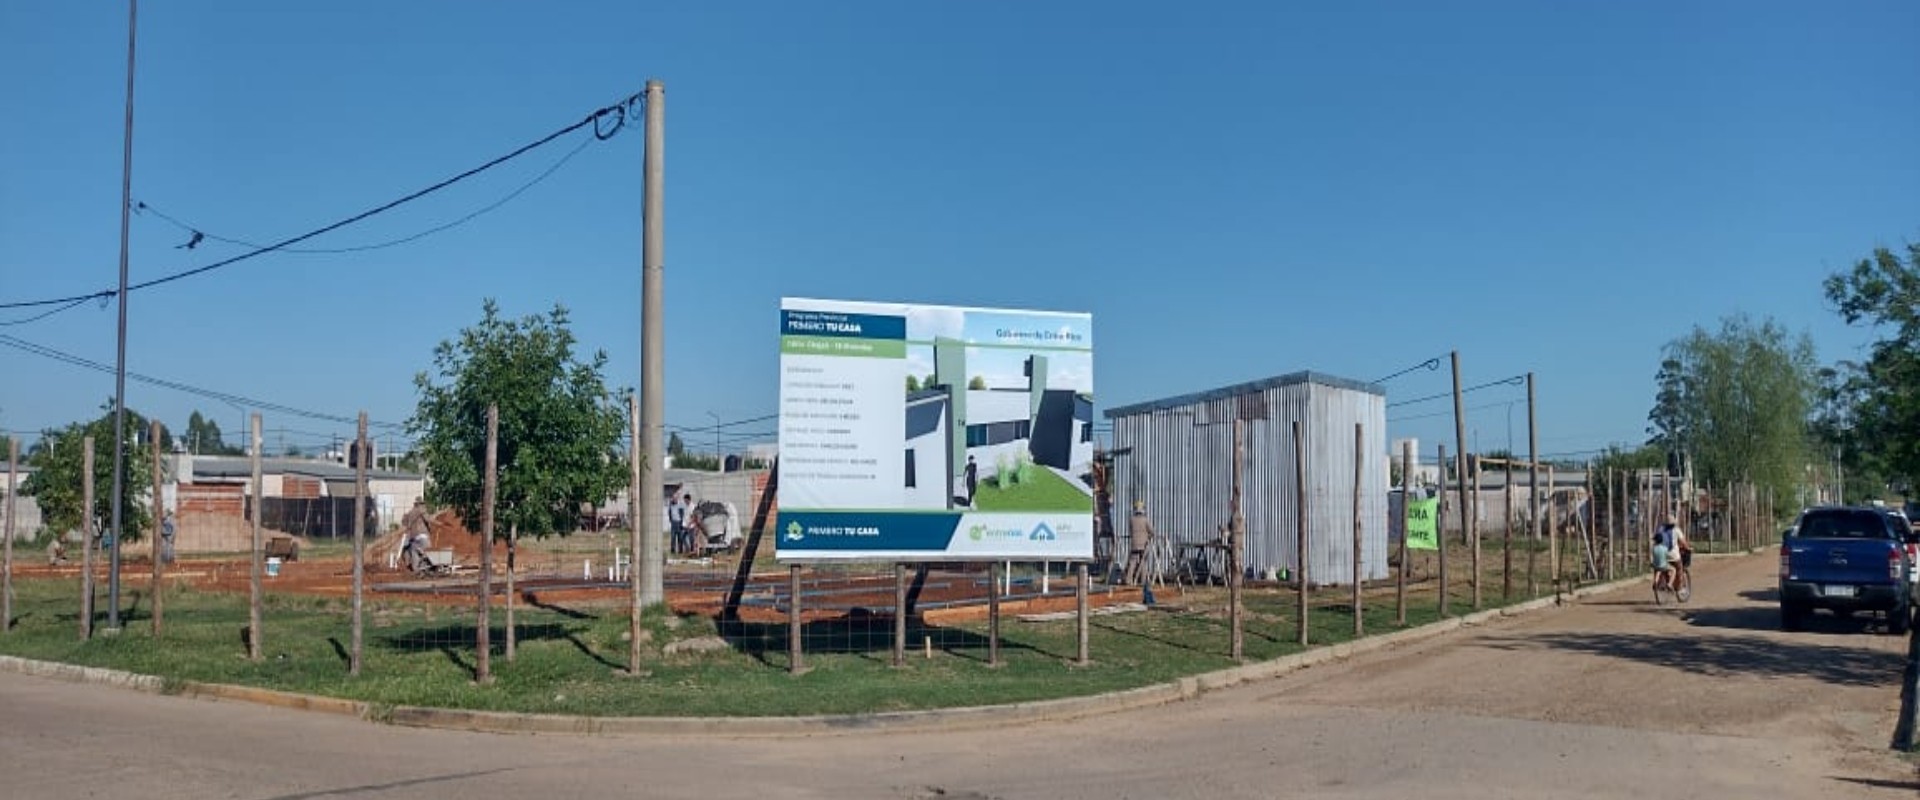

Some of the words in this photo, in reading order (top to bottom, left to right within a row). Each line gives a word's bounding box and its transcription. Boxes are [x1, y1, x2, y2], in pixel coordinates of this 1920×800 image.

[826, 322, 837, 332] TU
[838, 323, 861, 333] CASA
[844, 526, 855, 536] TU
[856, 526, 880, 537] CASA
